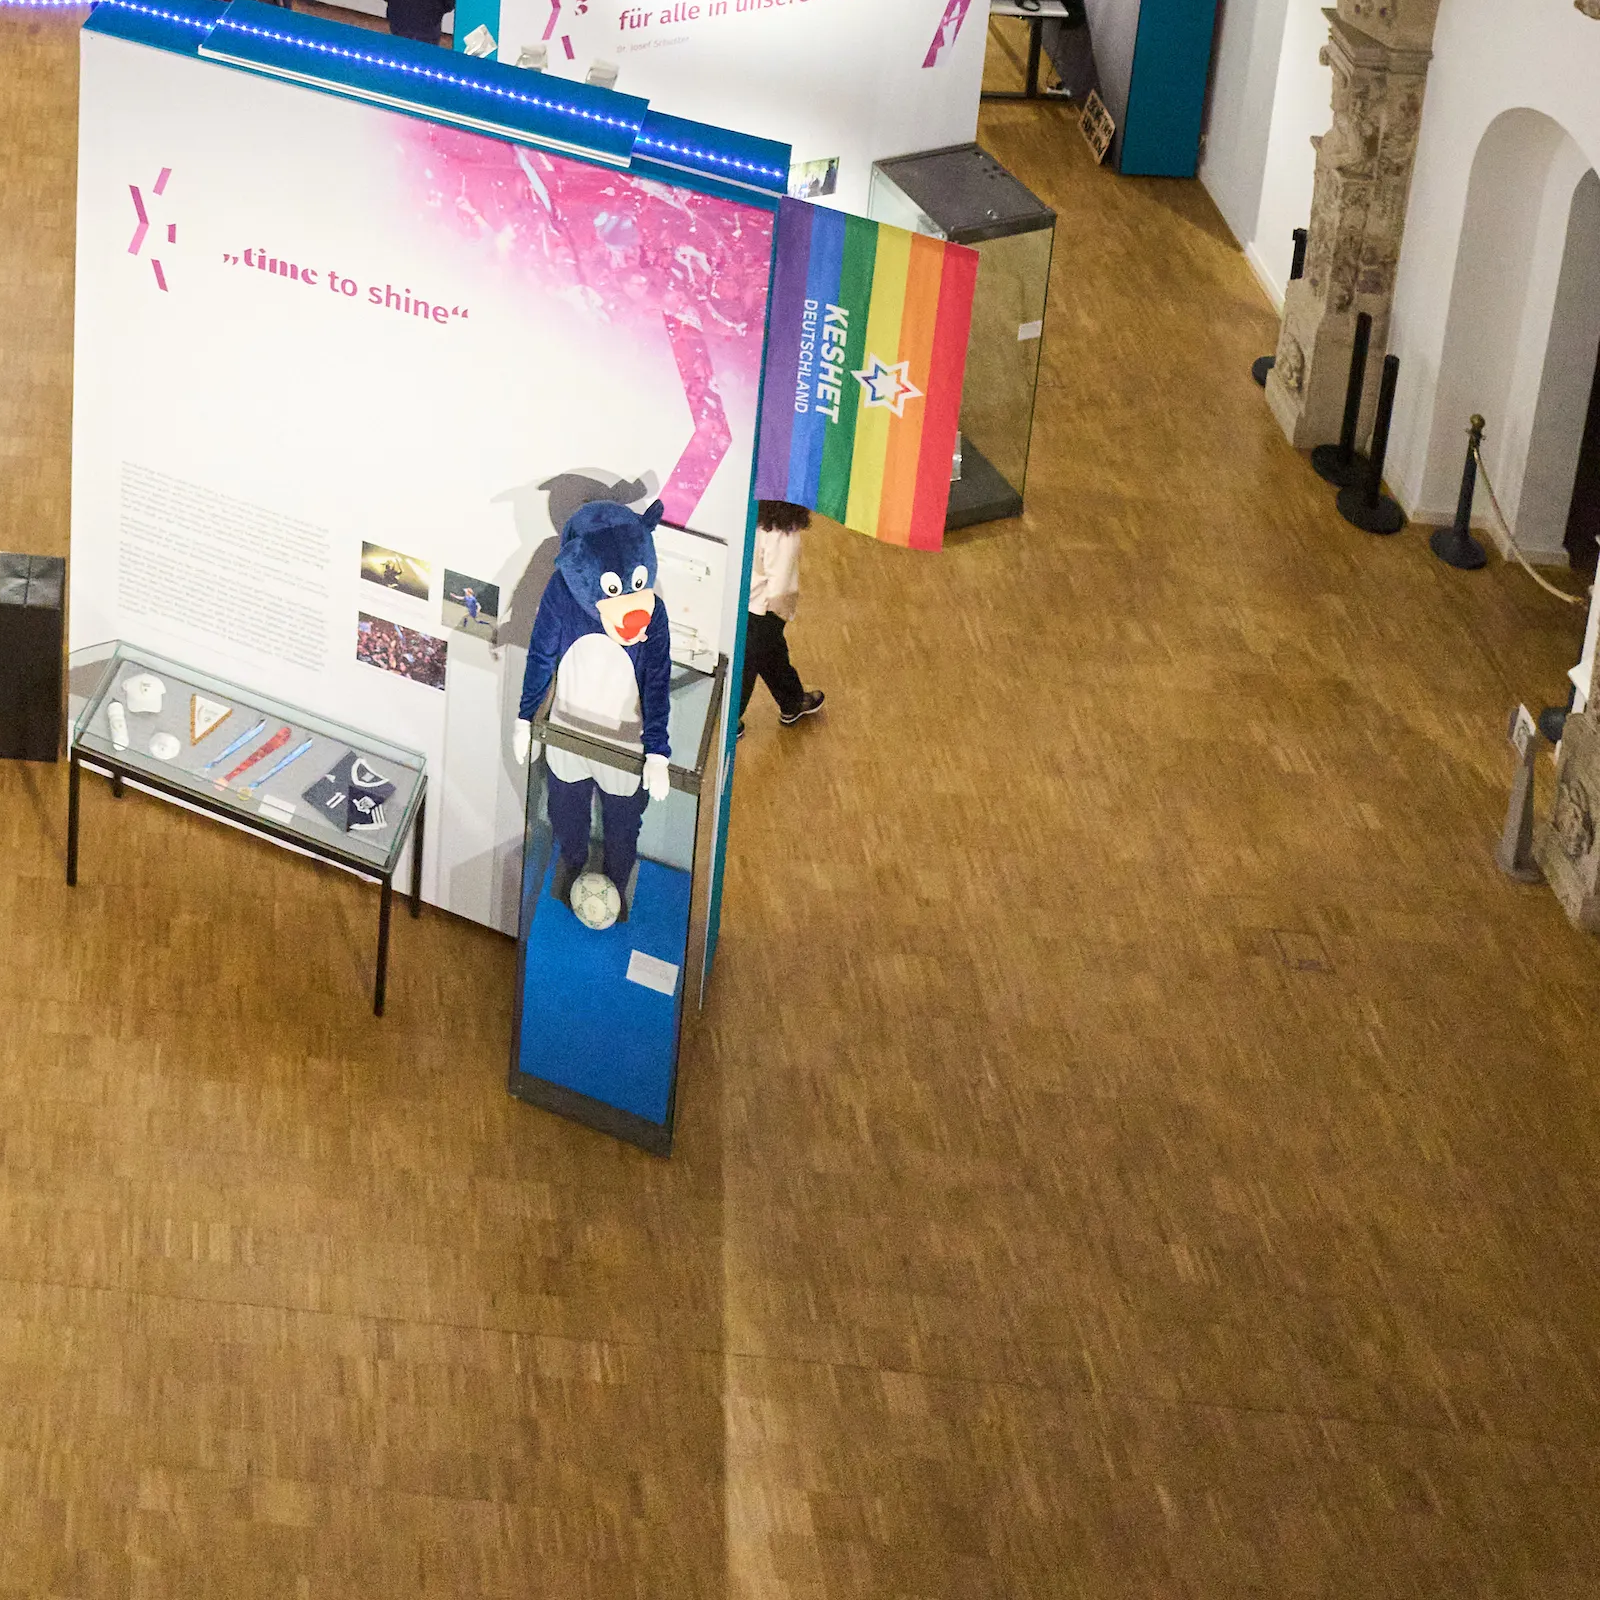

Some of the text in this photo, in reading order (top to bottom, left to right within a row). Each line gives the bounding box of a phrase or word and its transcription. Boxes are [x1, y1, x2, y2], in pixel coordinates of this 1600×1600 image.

[618, 7, 653, 31] für
[659, 1, 701, 26] alle
[166, 223, 176, 244] 1
[223, 248, 469, 325] „time to shine“
[794, 299, 818, 413] DEUTSCHLAND
[816, 303, 849, 424] KESHET
